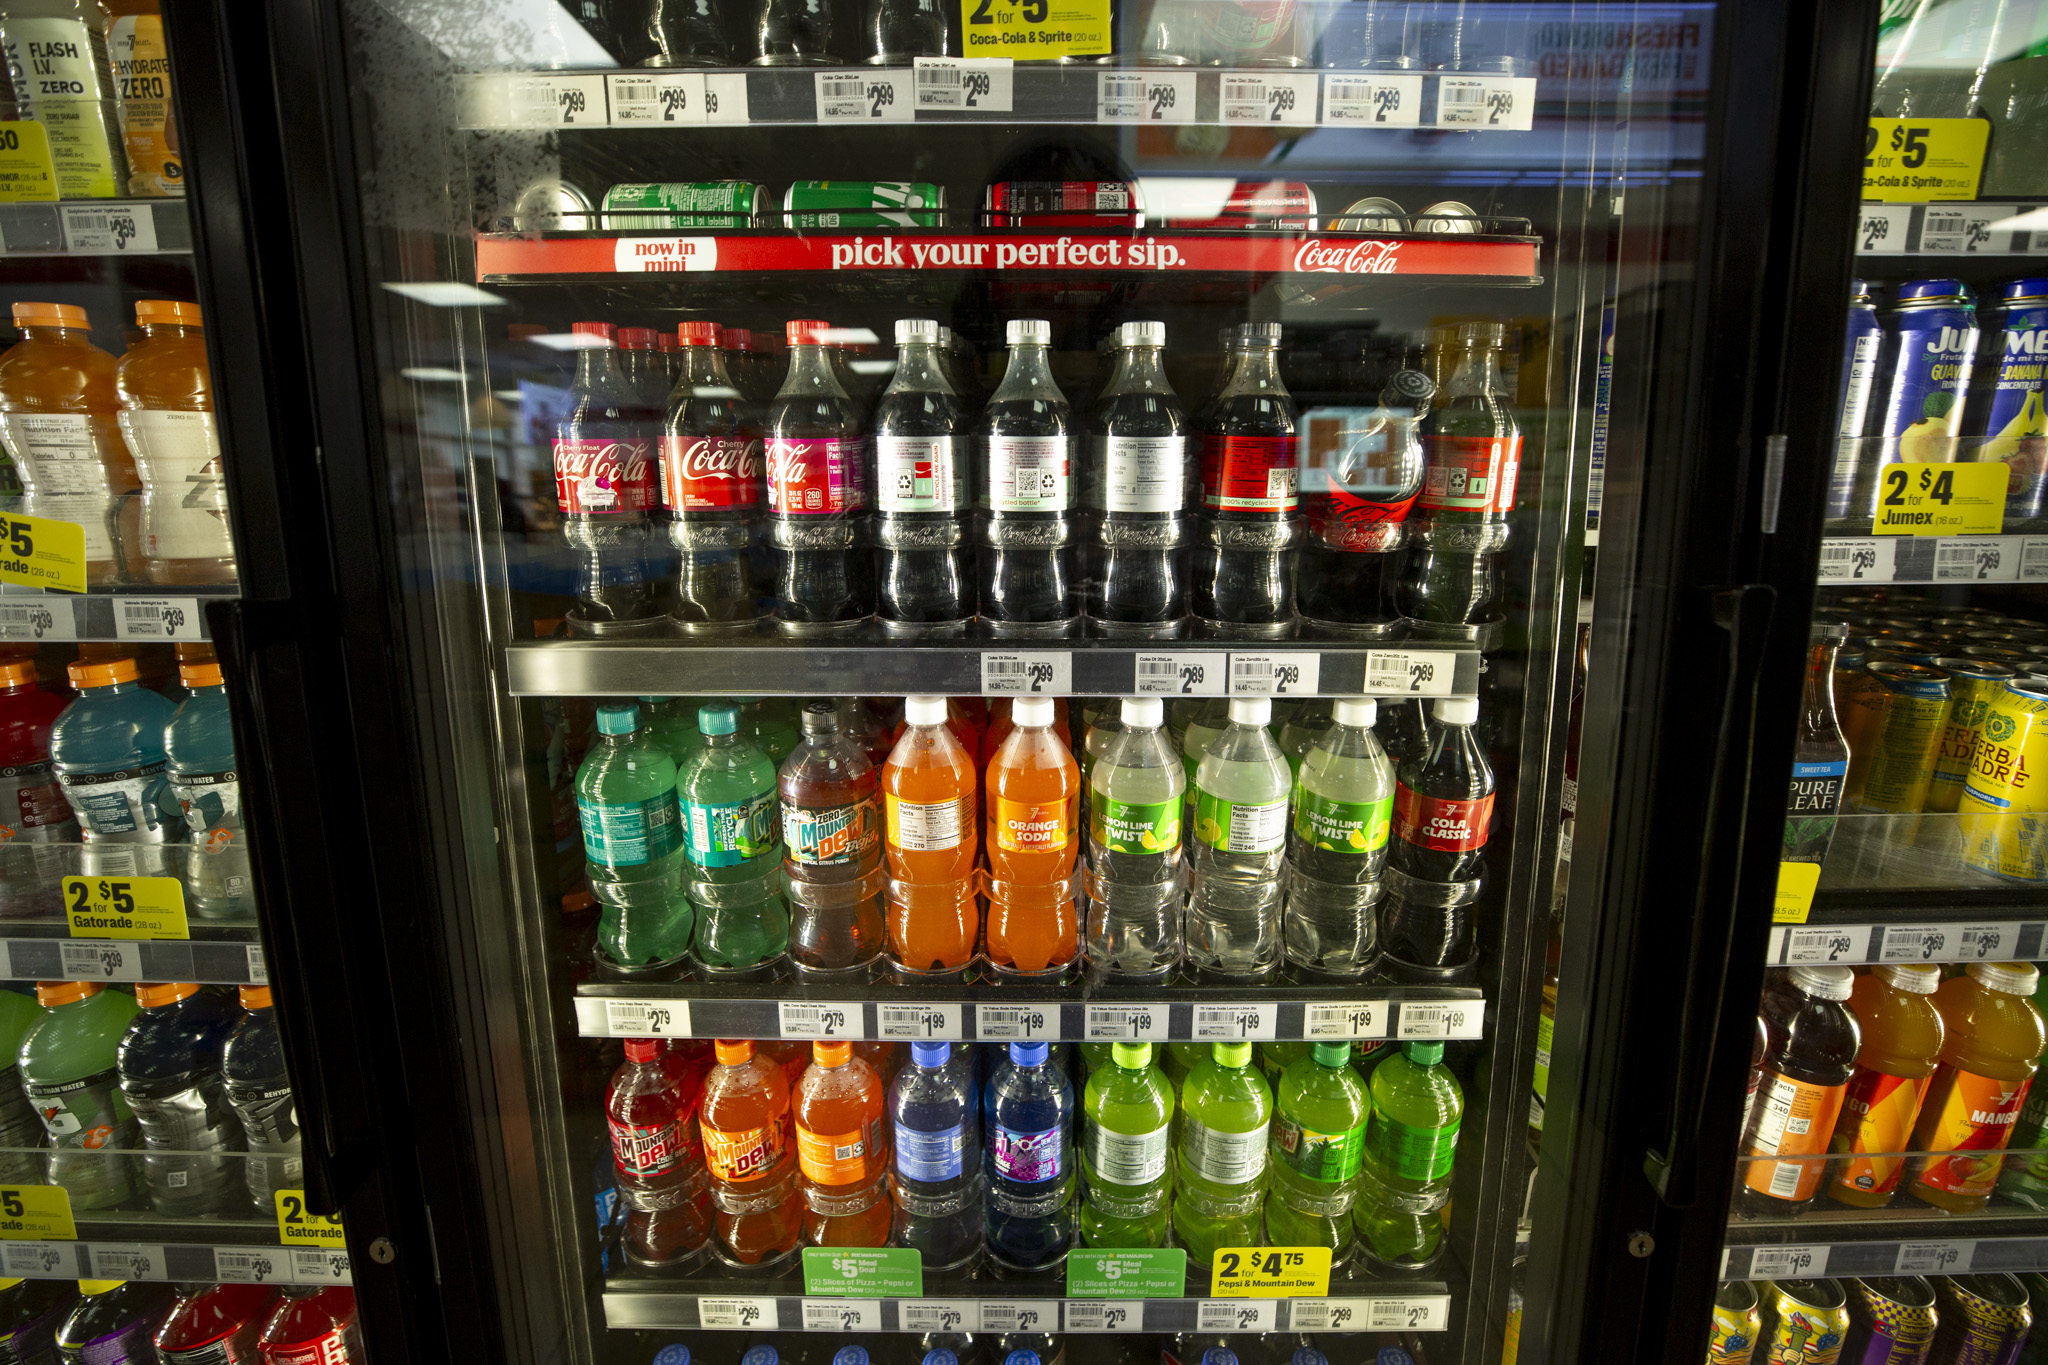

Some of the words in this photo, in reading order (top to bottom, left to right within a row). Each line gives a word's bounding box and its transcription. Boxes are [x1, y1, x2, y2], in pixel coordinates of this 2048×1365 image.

[970, 0, 994, 25] 2
[997, 11, 1014, 23] for
[970, 32, 1026, 46] Coca-Cola
[1029, 33, 1037, 44] &
[1039, 30, 1072, 44] Sprite
[1074, 32, 1086, 43] (20
[1088, 31, 1102, 43] oz.)
[29, 42, 79, 59] FLASH
[35, 58, 56, 75] I.V.
[39, 81, 85, 95] ZERO
[122, 76, 165, 100] ZERO
[1878, 155, 1894, 168] for
[1891, 125, 1930, 168] $5
[1902, 176, 1909, 187] &
[1911, 175, 1943, 189] Sprite
[635, 241, 676, 256] now
[678, 239, 696, 256] in
[831, 237, 905, 269] pick
[910, 243, 989, 269] your
[995, 237, 1122, 269] perfect
[1127, 238, 1187, 269] sip.
[1293, 239, 1403, 274] Coca-Cola
[2018, 354, 2032, 362] mi
[1995, 381, 2042, 390] CONCENTRATE
[717, 440, 744, 449] Cherry
[553, 442, 650, 482] Coca-Cola
[933, 444, 941, 466] AGAIN
[933, 468, 941, 476] ME
[807, 489, 821, 498] 260
[933, 476, 941, 500] RECYCLE
[1885, 470, 1909, 506] 2
[1908, 494, 1923, 506] for
[1919, 468, 1954, 505] $4
[1241, 499, 1265, 507] recycled
[1882, 509, 1933, 525] Jumex
[1935, 516, 1948, 525] (16
[1948, 515, 1963, 525] oz.)
[31, 565, 44, 577] (28
[1800, 766, 1819, 774] SWEET
[192, 775, 215, 784] WATER
[1232, 804, 1260, 813] Nutrition
[1232, 811, 1249, 819] Facts
[817, 809, 840, 823] ZERO
[1098, 812, 1129, 830] LEMON
[1130, 821, 1153, 830] LIME
[1305, 809, 1335, 828] LEMON
[1336, 819, 1363, 829] LIME
[1430, 817, 1467, 829] COLA
[1008, 819, 1059, 831] ORANGE
[1310, 821, 1353, 841] TWIST
[1016, 831, 1051, 842] SODA
[1104, 825, 1145, 843] TWIST
[1422, 828, 1472, 840] CLASSIC
[914, 842, 925, 850] 270
[835, 858, 850, 866] PUNCH
[69, 881, 92, 912] 2
[99, 880, 134, 913] $5
[93, 903, 107, 913] for
[73, 915, 133, 929] Gatorade
[135, 921, 148, 930] (28
[149, 921, 162, 930] oz.)
[59, 1081, 86, 1094] WATER
[1776, 1081, 1796, 1095] Facts
[1772, 1103, 1789, 1115] 340
[1971, 1109, 2018, 1125] MANGO
[283, 1196, 303, 1223] 2
[305, 1215, 320, 1224] for
[286, 1226, 342, 1239] Gatorade
[832, 1259, 858, 1278] $5
[1097, 1260, 1121, 1279] $5
[1219, 1253, 1240, 1278] 2
[1241, 1268, 1255, 1278] for
[810, 1278, 821, 1286] (2)
[884, 1280, 904, 1288] Pepsi
[1072, 1280, 1083, 1288] (2)
[1146, 1280, 1166, 1288] Pepsi
[1218, 1280, 1243, 1289] Pepsi
[1244, 1280, 1251, 1288] &
[1252, 1279, 1295, 1288] Mountain
[1296, 1279, 1316, 1287] Dew
[1072, 1287, 1108, 1295] Mountain
